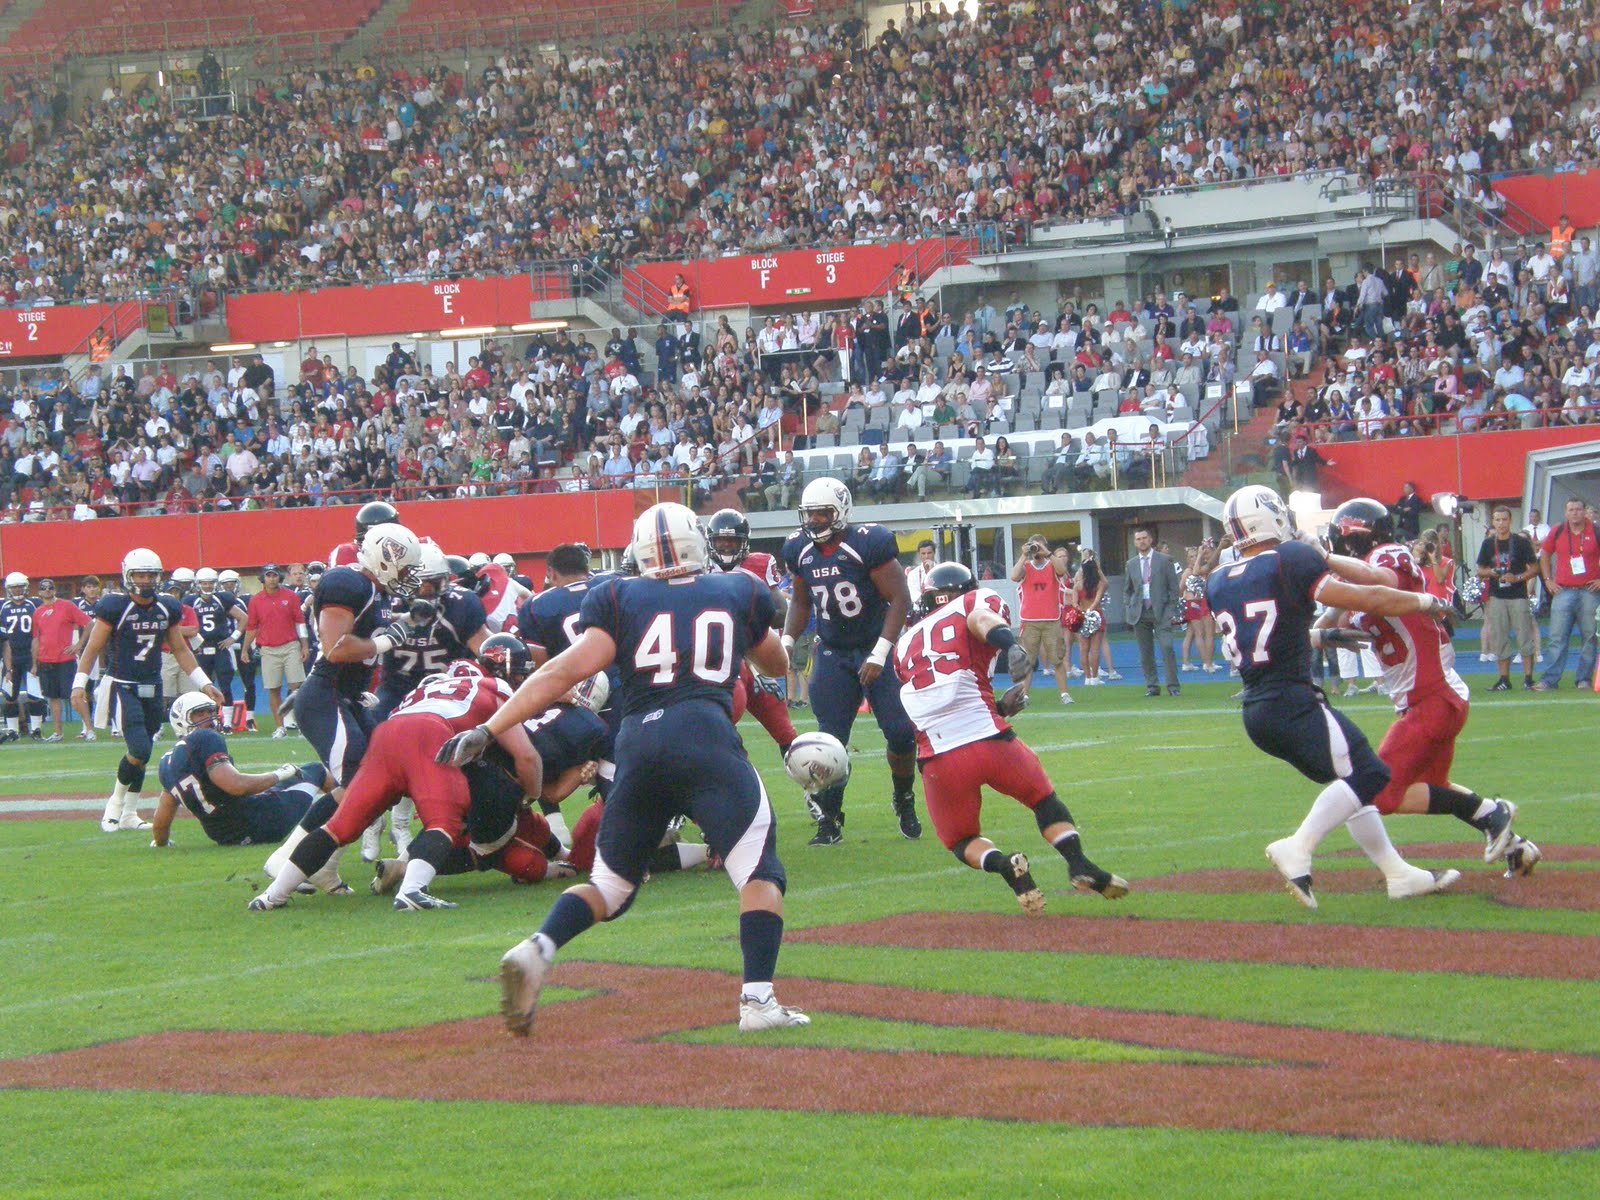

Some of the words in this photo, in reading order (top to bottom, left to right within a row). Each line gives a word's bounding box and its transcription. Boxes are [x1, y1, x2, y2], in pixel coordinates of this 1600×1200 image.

[751, 258, 778, 269] BLOCK
[816, 252, 845, 264] STIEGE
[760, 270, 770, 289] F
[826, 264, 836, 283] 3
[434, 284, 460, 295] BLOCK
[443, 295, 453, 314] E
[18, 312, 46, 322] STIEGE
[28, 323, 38, 341] 2
[655, 566, 687, 579] Riddell
[812, 566, 841, 578] USA
[1033, 583, 1046, 591] TV
[811, 581, 862, 621] 78
[6, 615, 32, 634] 70
[132, 622, 158, 630] USA
[202, 614, 215, 632] 5
[134, 634, 156, 661] 7
[405, 637, 439, 647] USA
[634, 610, 735, 684] 40
[900, 612, 971, 691] 49
[394, 649, 449, 677] 75
